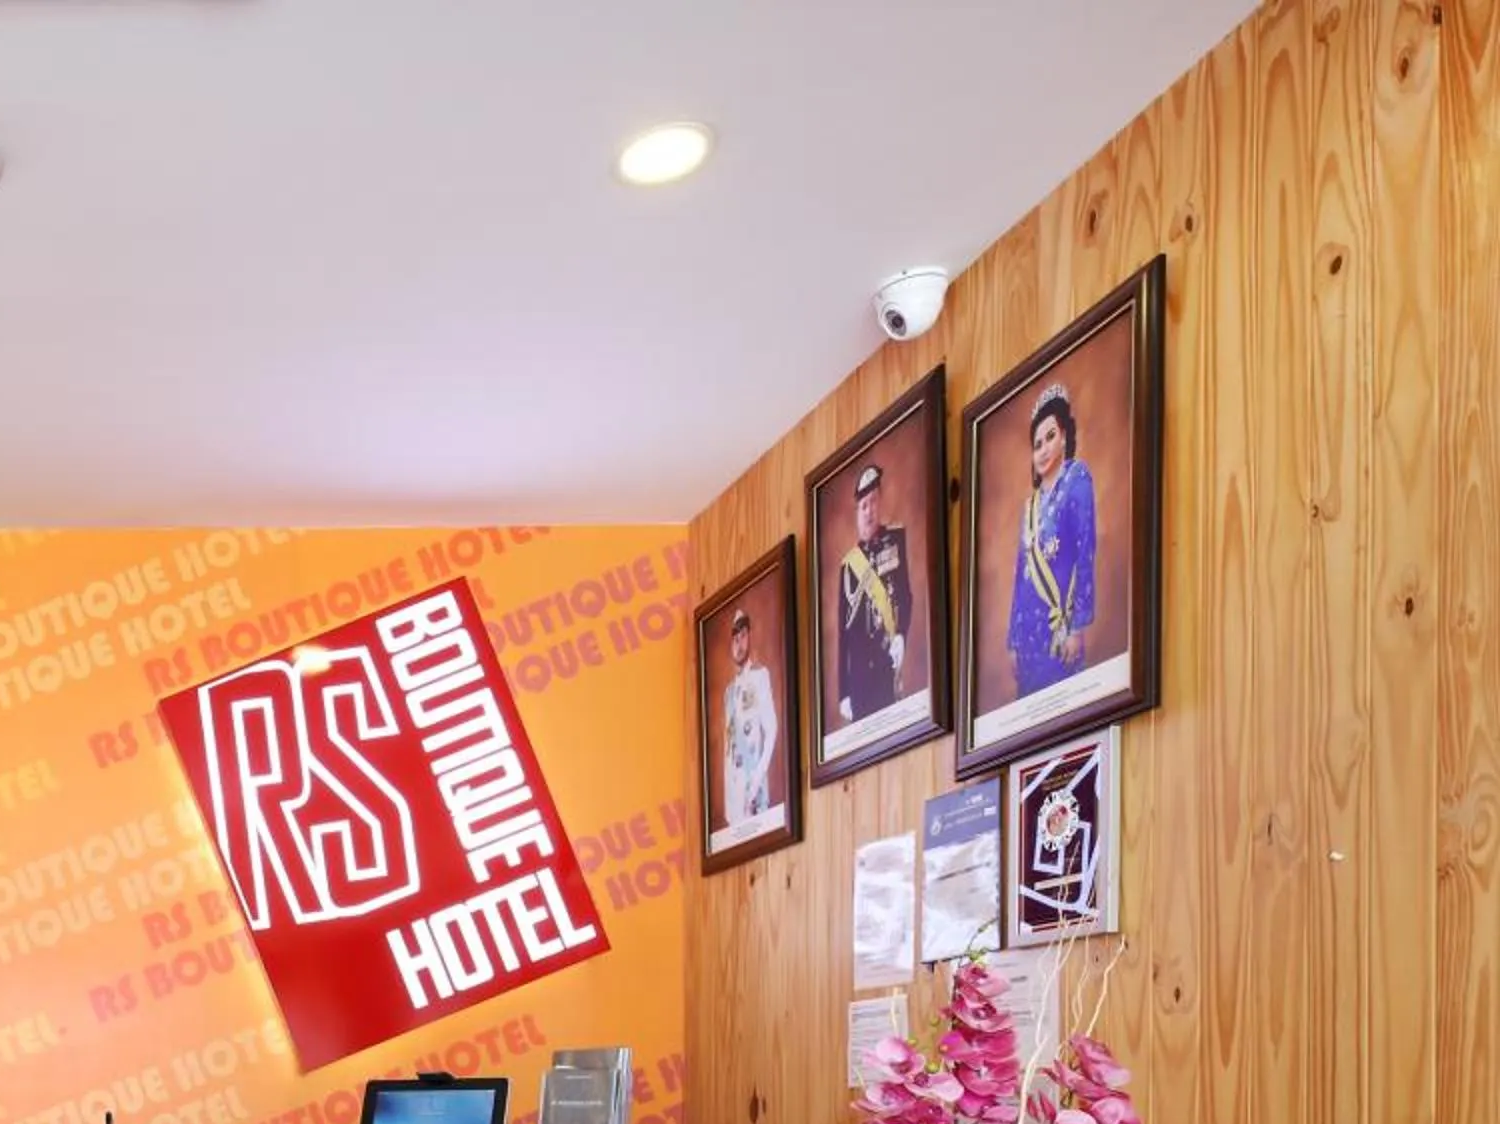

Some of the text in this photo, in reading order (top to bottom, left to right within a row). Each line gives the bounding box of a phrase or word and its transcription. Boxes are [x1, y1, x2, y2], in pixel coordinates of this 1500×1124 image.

[118, 577, 252, 657] HOTEL
[143, 646, 194, 695] RS
[199, 557, 413, 674] BOUTIQUE
[87, 720, 139, 769] RS
[198, 644, 421, 931] RS
[375, 590, 555, 884] BOUTIQUE
[141, 900, 193, 950] RS
[385, 866, 597, 1009] HOTEL
[88, 972, 139, 1024] RS
